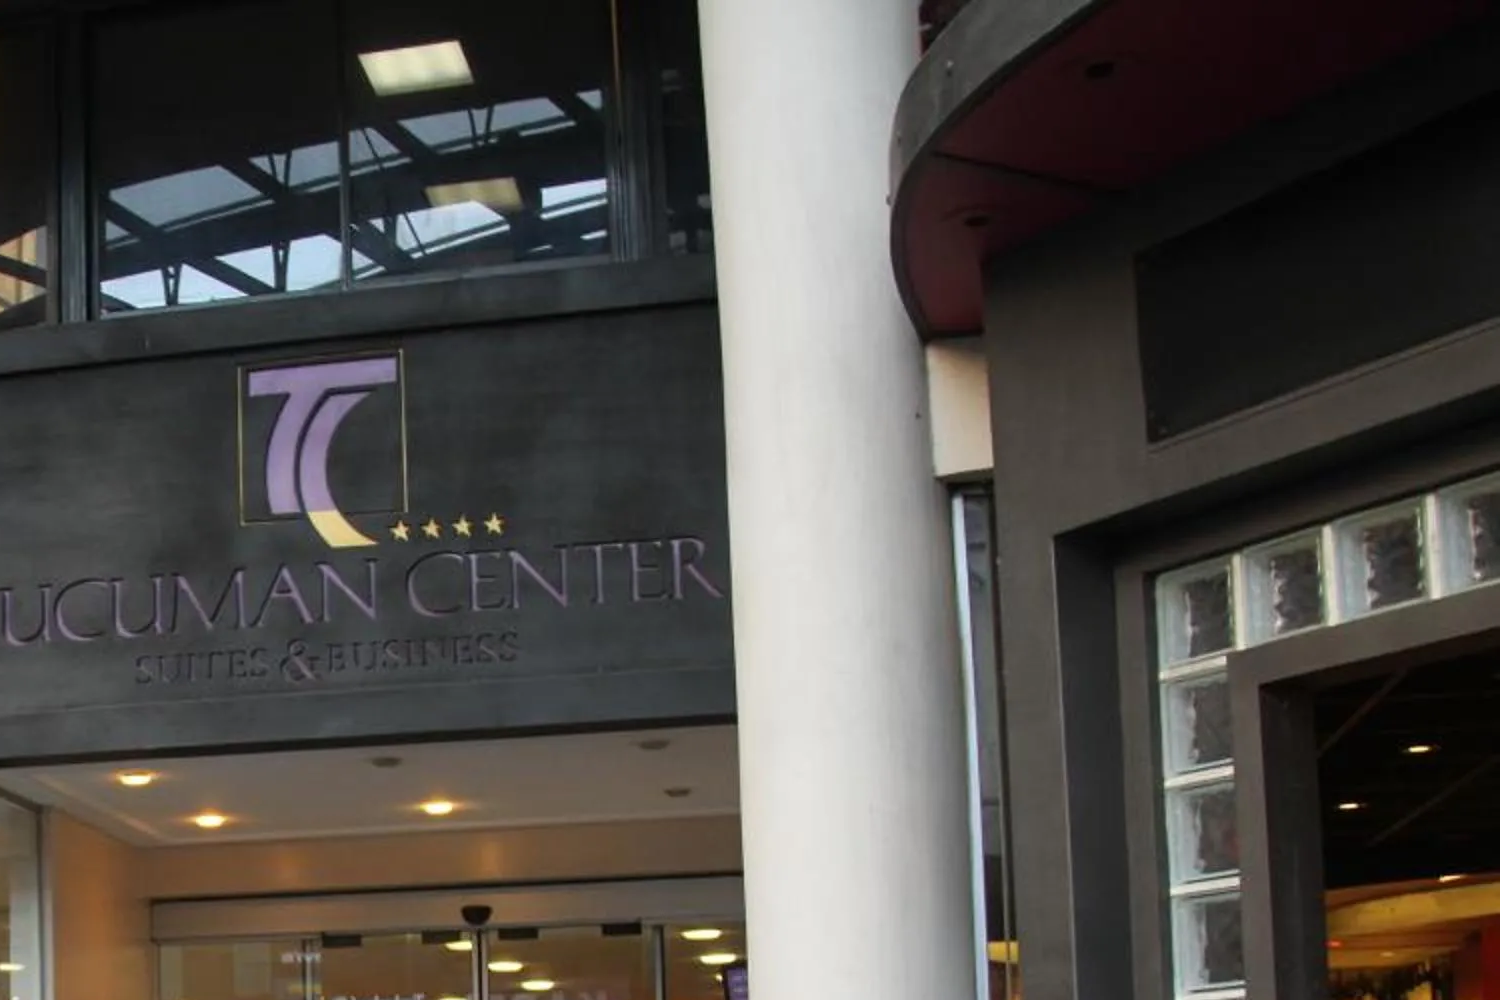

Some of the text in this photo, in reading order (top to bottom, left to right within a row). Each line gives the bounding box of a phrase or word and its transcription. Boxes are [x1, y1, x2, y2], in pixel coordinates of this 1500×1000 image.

[405, 534, 725, 618] CENTER
[134, 631, 518, 684] SUITES & BUSINESS
